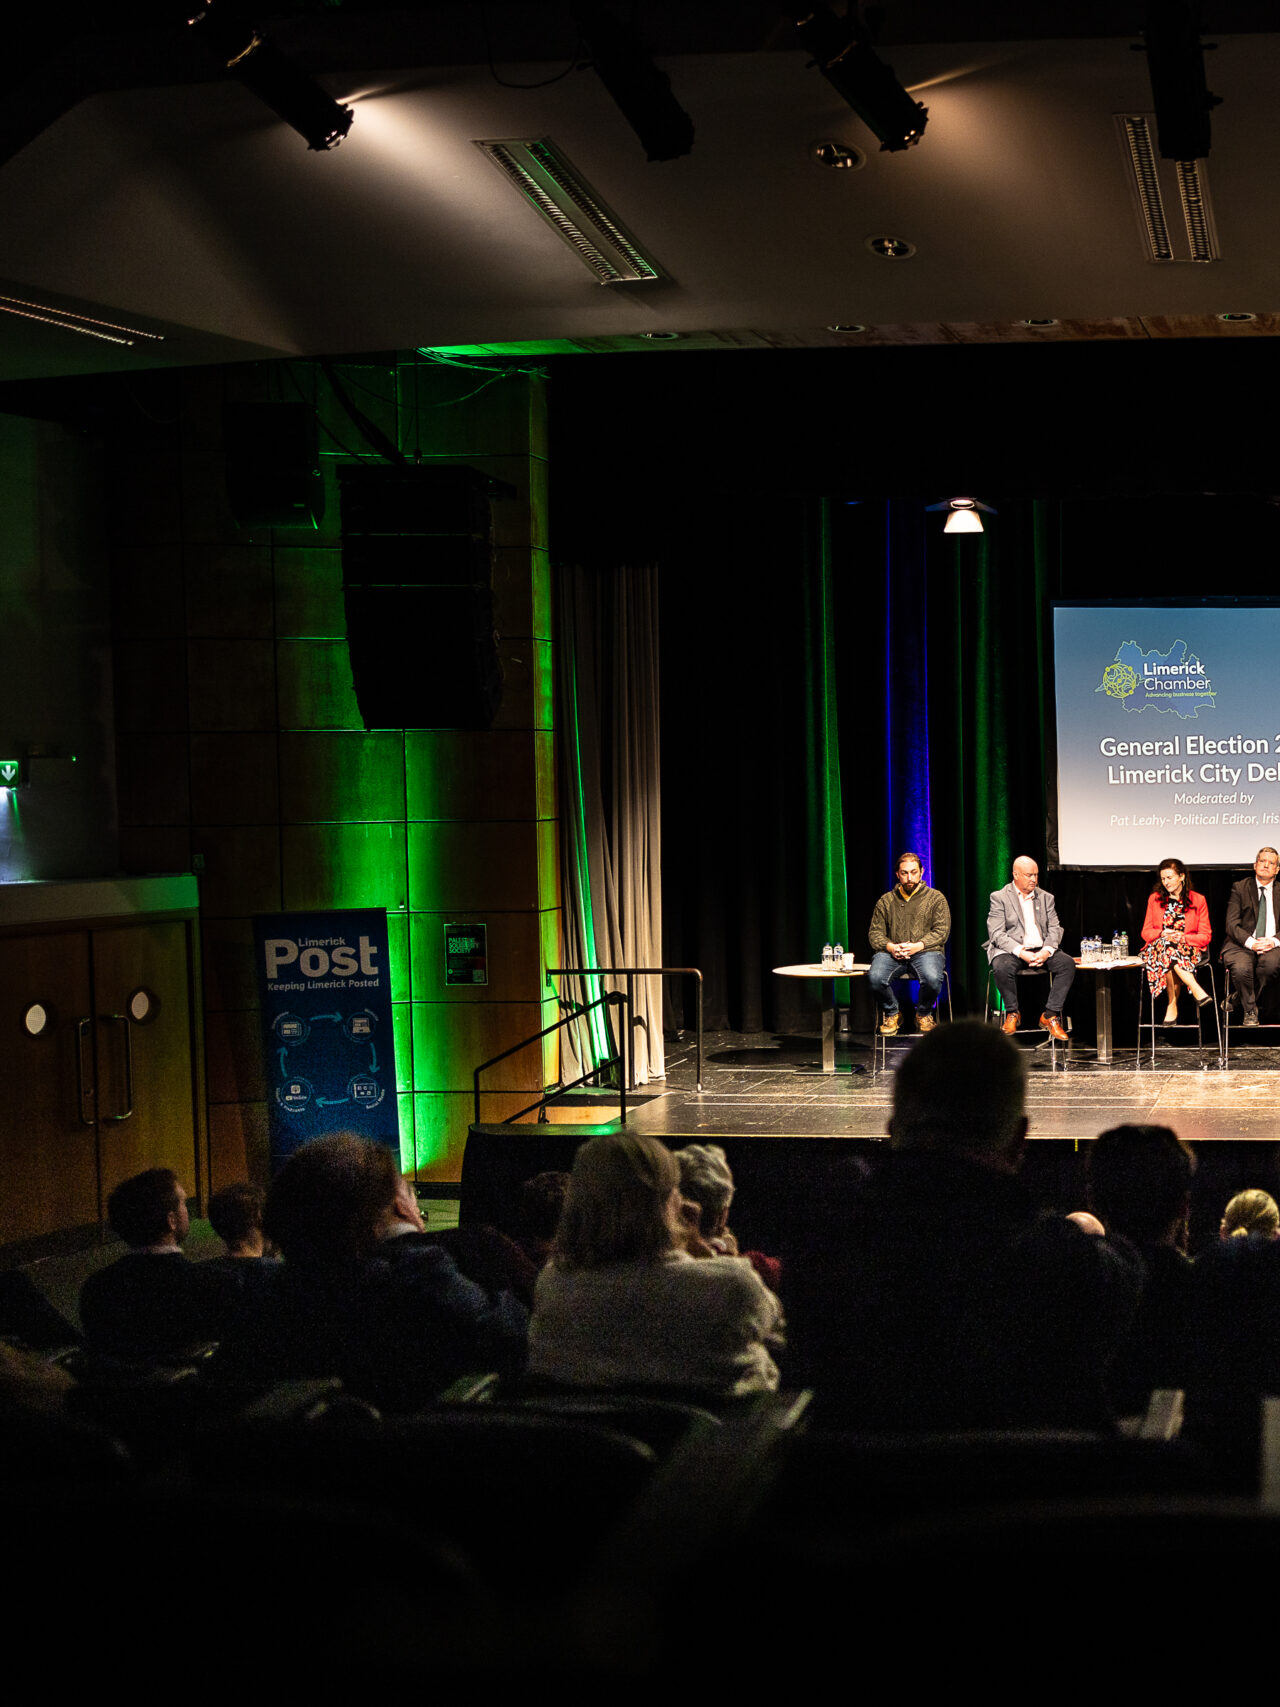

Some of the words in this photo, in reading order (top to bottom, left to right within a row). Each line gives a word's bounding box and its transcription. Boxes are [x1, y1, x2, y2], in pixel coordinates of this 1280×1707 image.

[1143, 661, 1205, 675] Limerick
[1143, 677, 1211, 690] Chamber
[1100, 736, 1180, 757] General
[1186, 735, 1269, 755] Election
[1108, 764, 1194, 784] Limerick
[1200, 763, 1242, 786] City
[1174, 792, 1237, 805] Moderated
[1240, 792, 1255, 806] by
[1110, 814, 1129, 826] Pat
[1133, 814, 1170, 828] Leahy-
[1174, 813, 1219, 826] Political
[1222, 812, 1259, 826] Editor,
[298, 937, 346, 947] Limerick
[264, 935, 379, 979] Post
[267, 982, 305, 992] Keeping
[307, 980, 346, 989] Limerick
[349, 978, 379, 988] Posted
